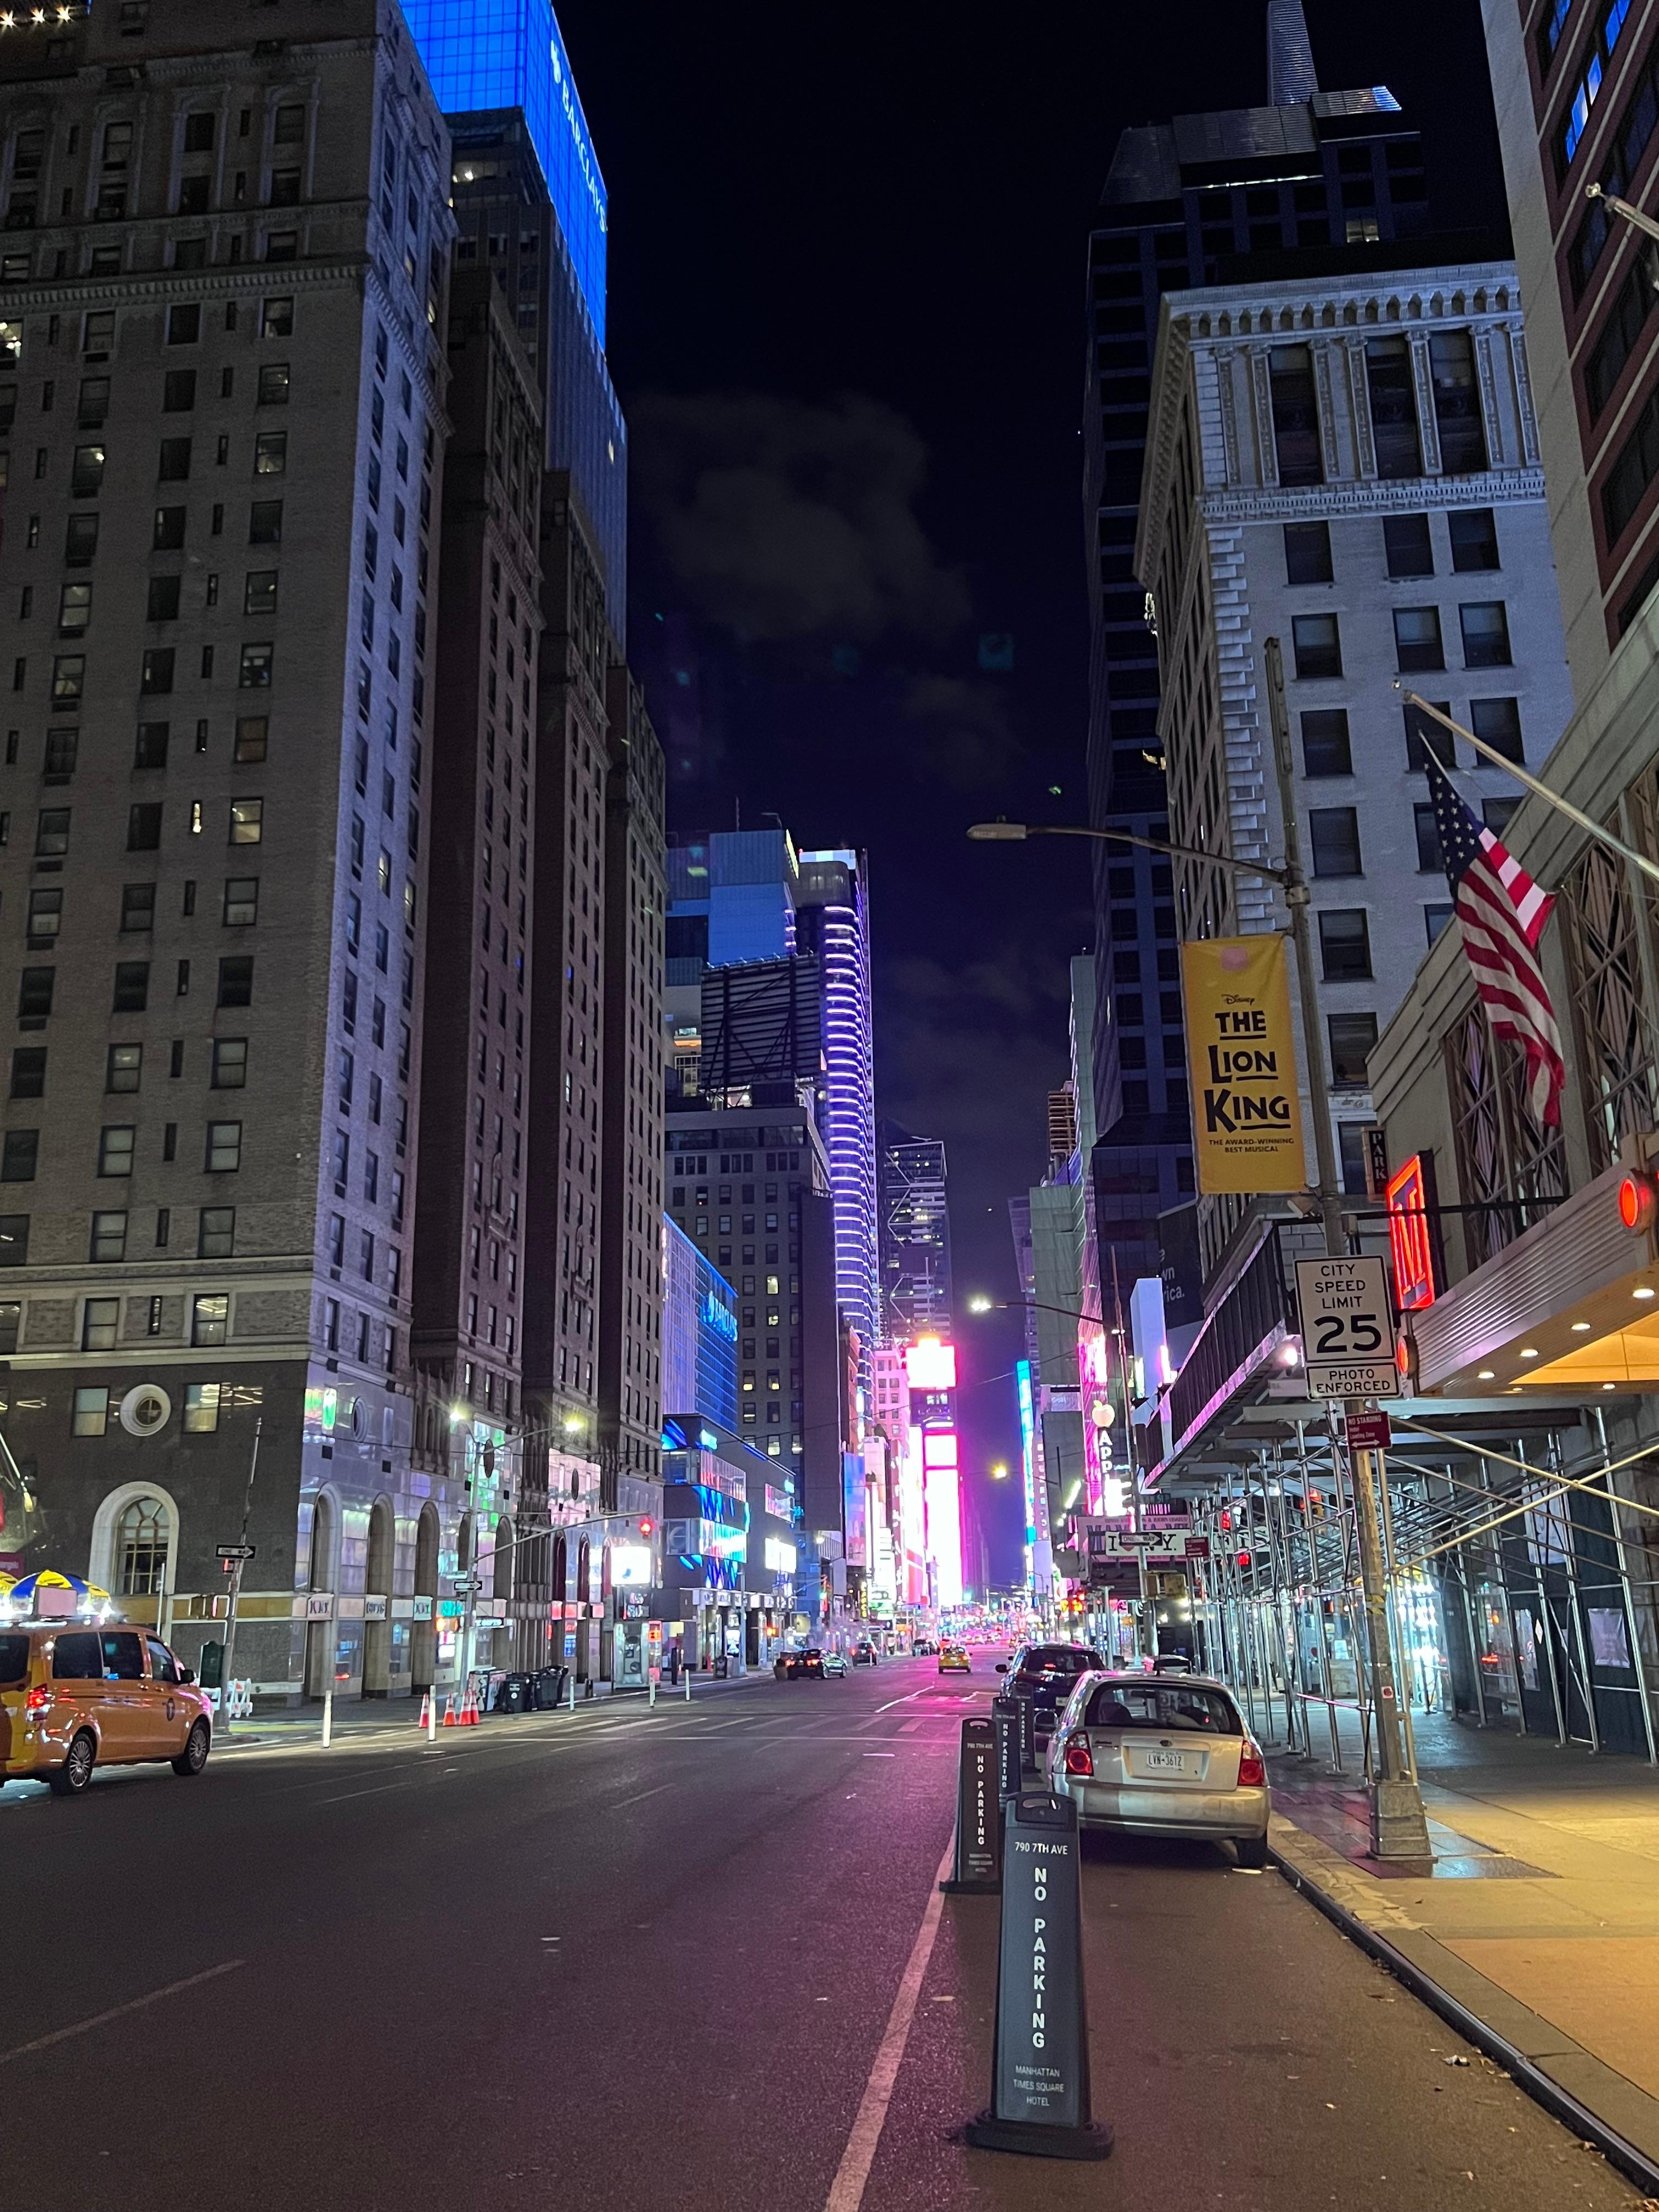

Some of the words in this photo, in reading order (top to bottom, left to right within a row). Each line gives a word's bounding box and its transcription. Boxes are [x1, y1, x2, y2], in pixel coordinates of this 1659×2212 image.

[562, 78, 607, 233] BARCLAYS
[1215, 1011, 1266, 1033] THE
[1208, 1045, 1277, 1084] LION
[1204, 1088, 1290, 1133] KING
[1372, 1133, 1387, 1180] PARK
[1321, 1264, 1355, 1277] CITY
[1315, 1280, 1365, 1293] SPEED
[1322, 1296, 1362, 1309] LIMIT
[1314, 1314, 1381, 1353] 25
[1329, 1369, 1374, 1380] PHOTO
[1317, 1381, 1390, 1393] ENFORCED
[1003, 1723, 1008, 1736] NO
[977, 1756, 984, 1773] NO
[1015, 1842, 1030, 1853] 790
[1032, 1843, 1049, 1853] 7TH
[1051, 1845, 1068, 1855] AVE
[1034, 1867, 1047, 1901] NO
[1032, 1918, 1046, 2048] PARKING
[1015, 2064, 1060, 2077] MANHATTAN
[1013, 2079, 1034, 2090] TIMES
[1035, 2082, 1064, 2093] SQUARE
[1026, 2096, 1050, 2106] HOTEL
